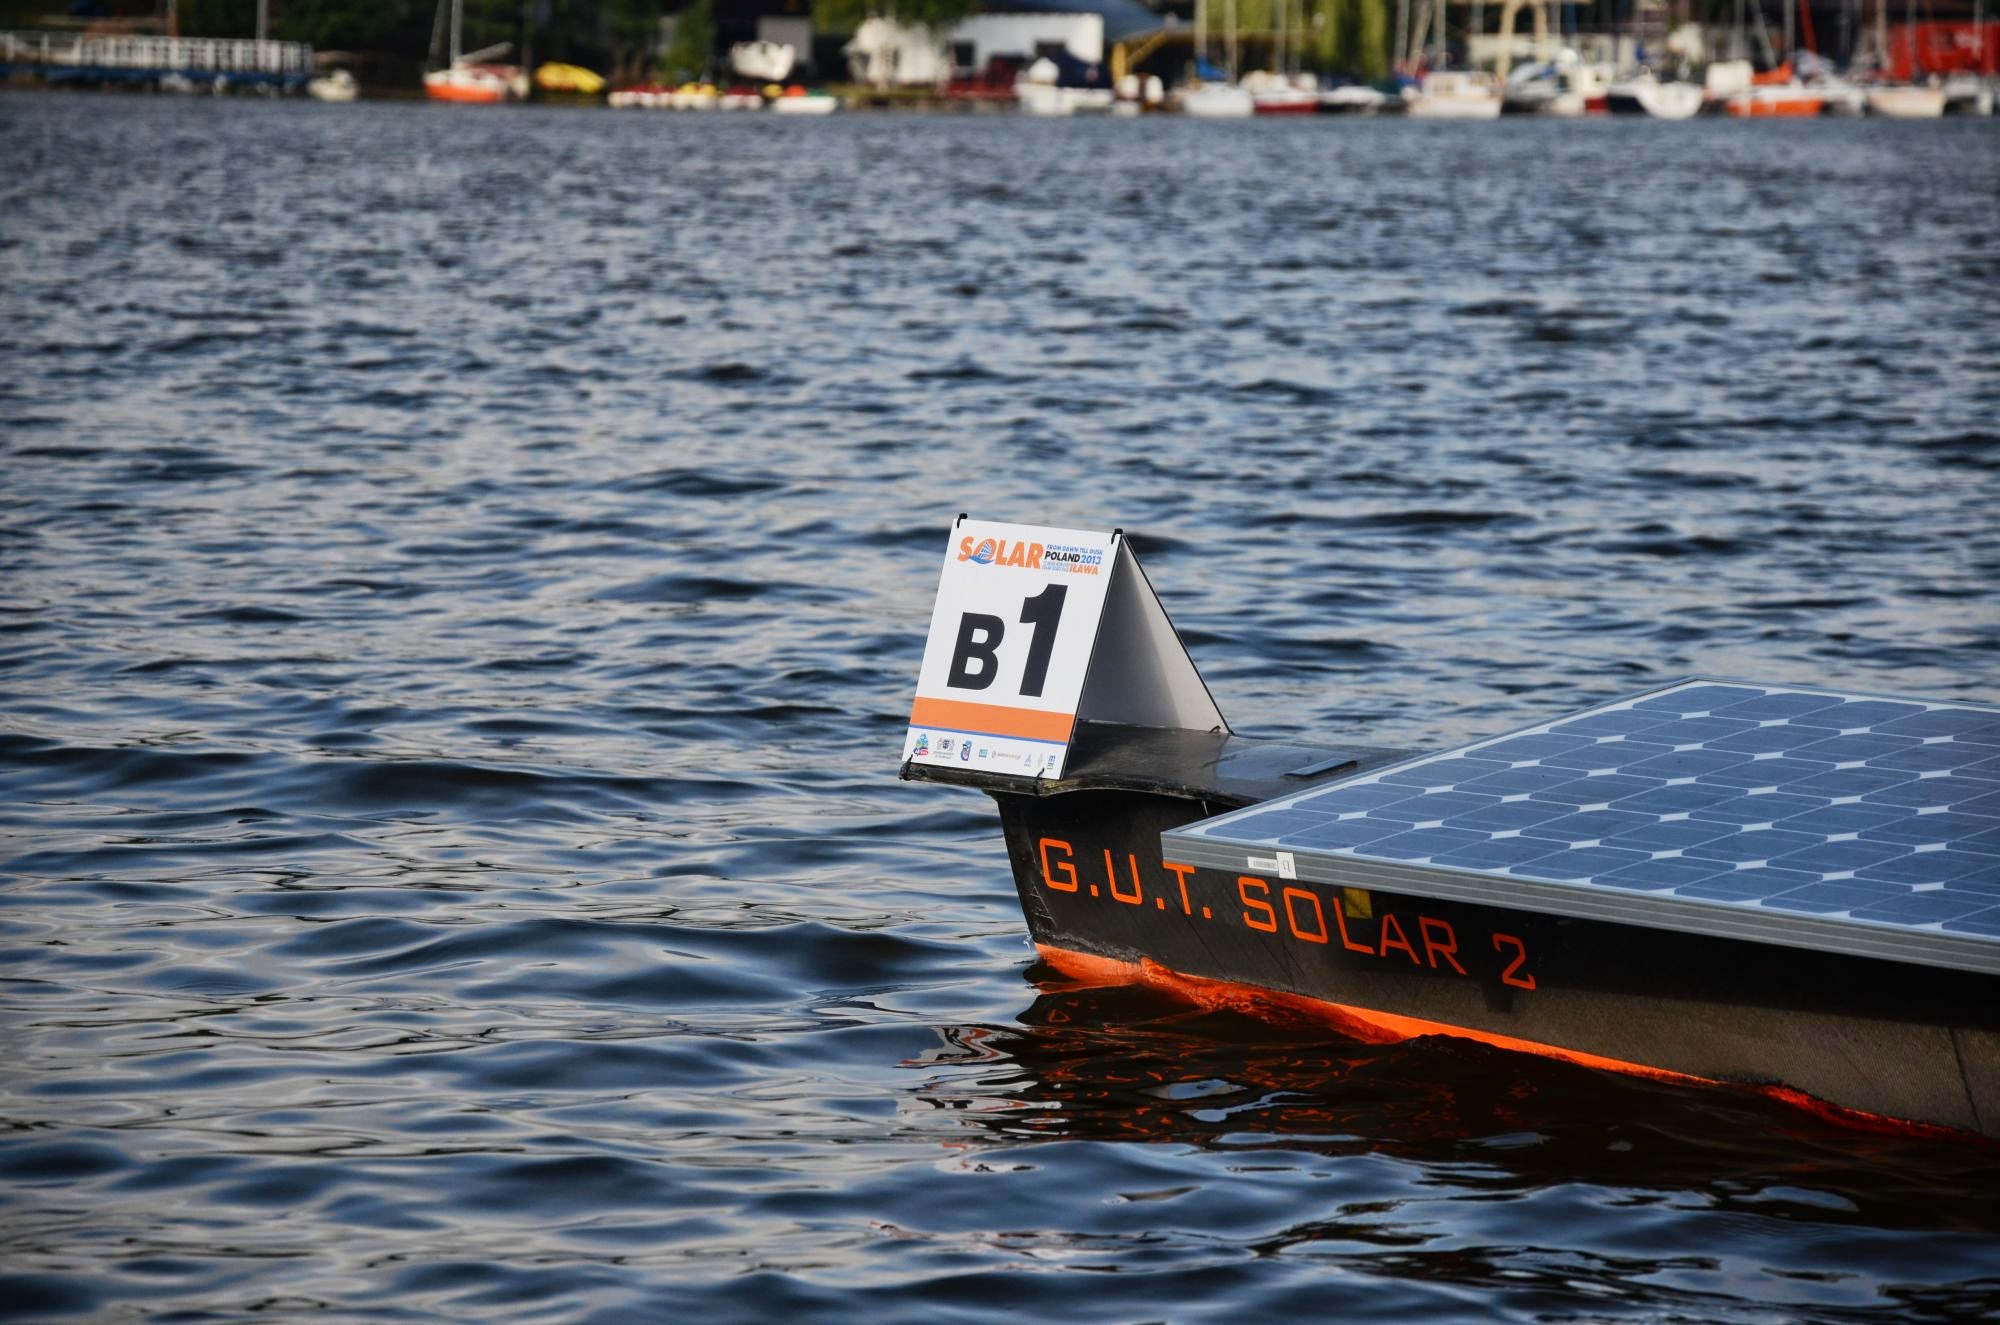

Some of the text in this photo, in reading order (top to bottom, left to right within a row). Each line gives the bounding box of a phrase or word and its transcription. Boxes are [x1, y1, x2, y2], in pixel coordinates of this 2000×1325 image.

[957, 536, 1044, 570] SOLAR
[1044, 551, 1102, 565] POLAND 2013
[946, 583, 1068, 698] B1
[1039, 837, 1536, 990] G.U.T. SOLAR 2
